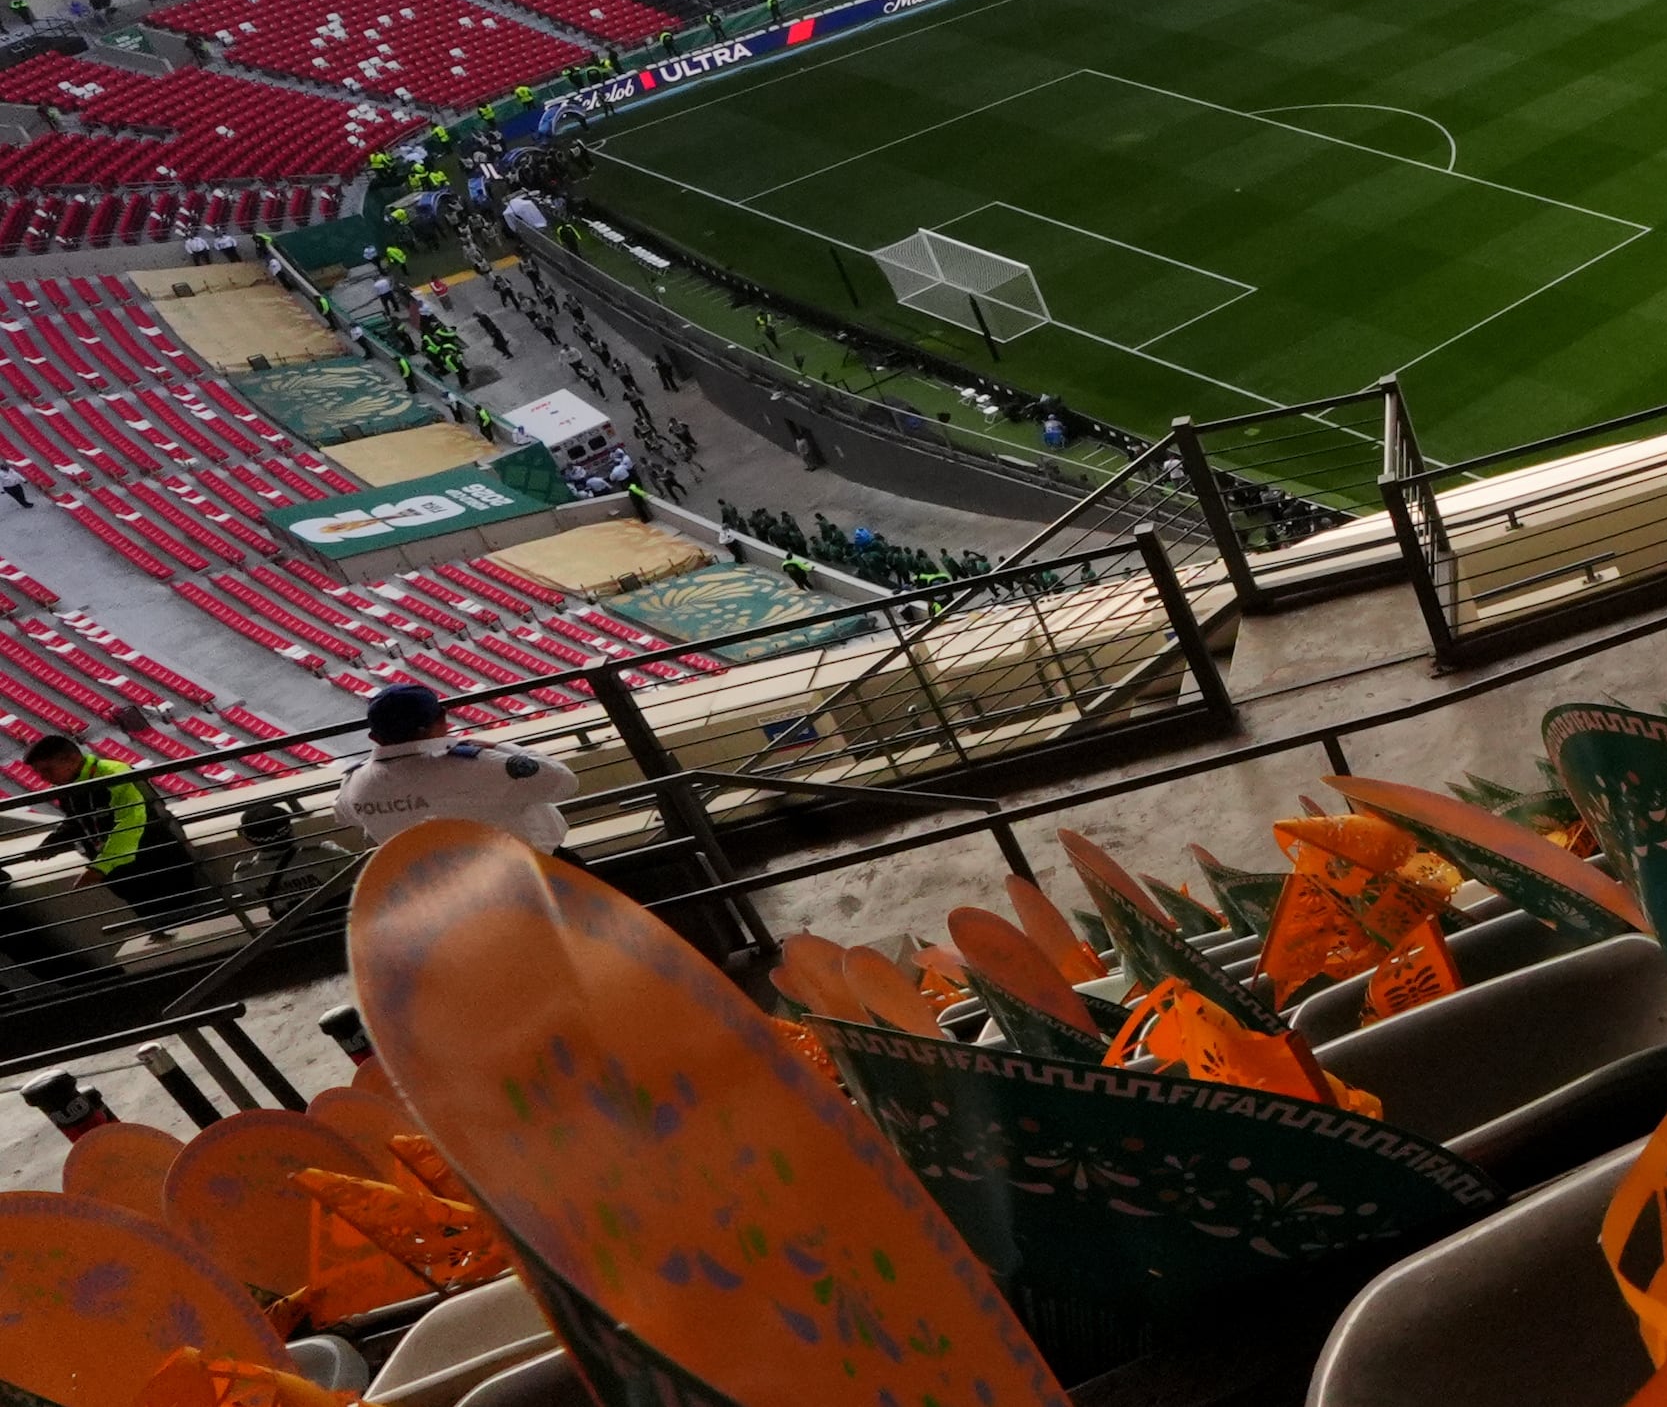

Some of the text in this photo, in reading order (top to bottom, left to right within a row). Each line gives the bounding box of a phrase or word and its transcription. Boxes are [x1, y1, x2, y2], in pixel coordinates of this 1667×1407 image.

[659, 43, 752, 82] ULTRA
[353, 794, 429, 816] POLICÍA
[921, 1045, 996, 1076] FIFA
[1168, 1085, 1258, 1119] FIFA
[1404, 1148, 1458, 1191] FIFA
